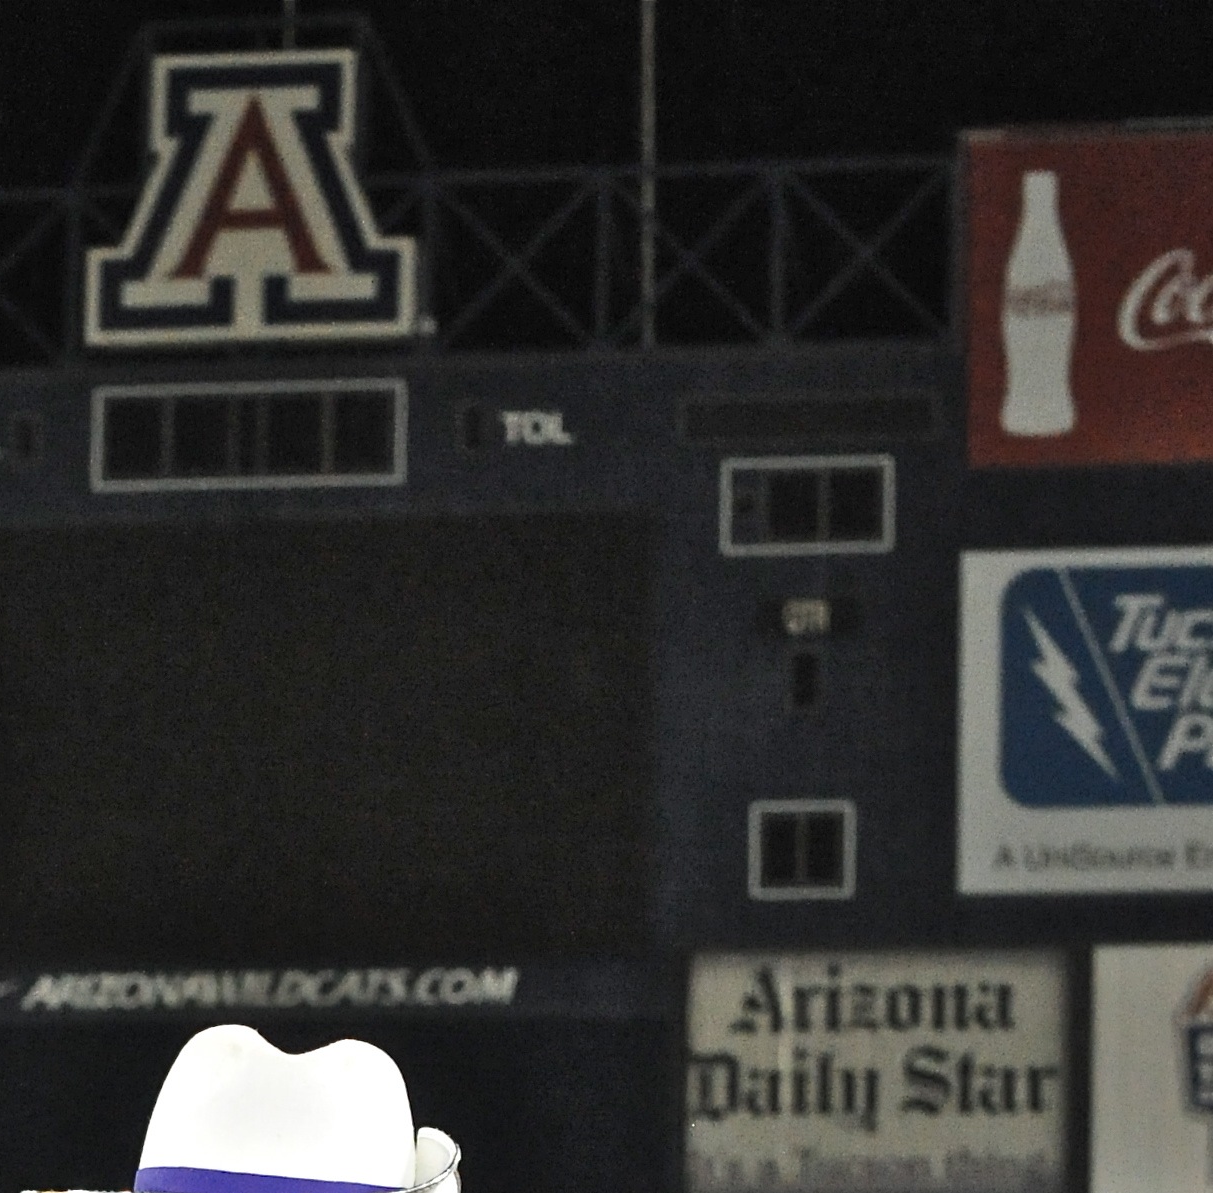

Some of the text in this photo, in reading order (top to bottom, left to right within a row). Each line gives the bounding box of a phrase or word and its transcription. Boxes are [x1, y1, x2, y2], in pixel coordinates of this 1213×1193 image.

[86, 47, 418, 347] A
[502, 411, 573, 446] TOL
[22, 967, 519, 1013] ARIZONAWILDCATS.COM
[730, 963, 1015, 1035] Arizona
[690, 1044, 1057, 1133] Daily Star
